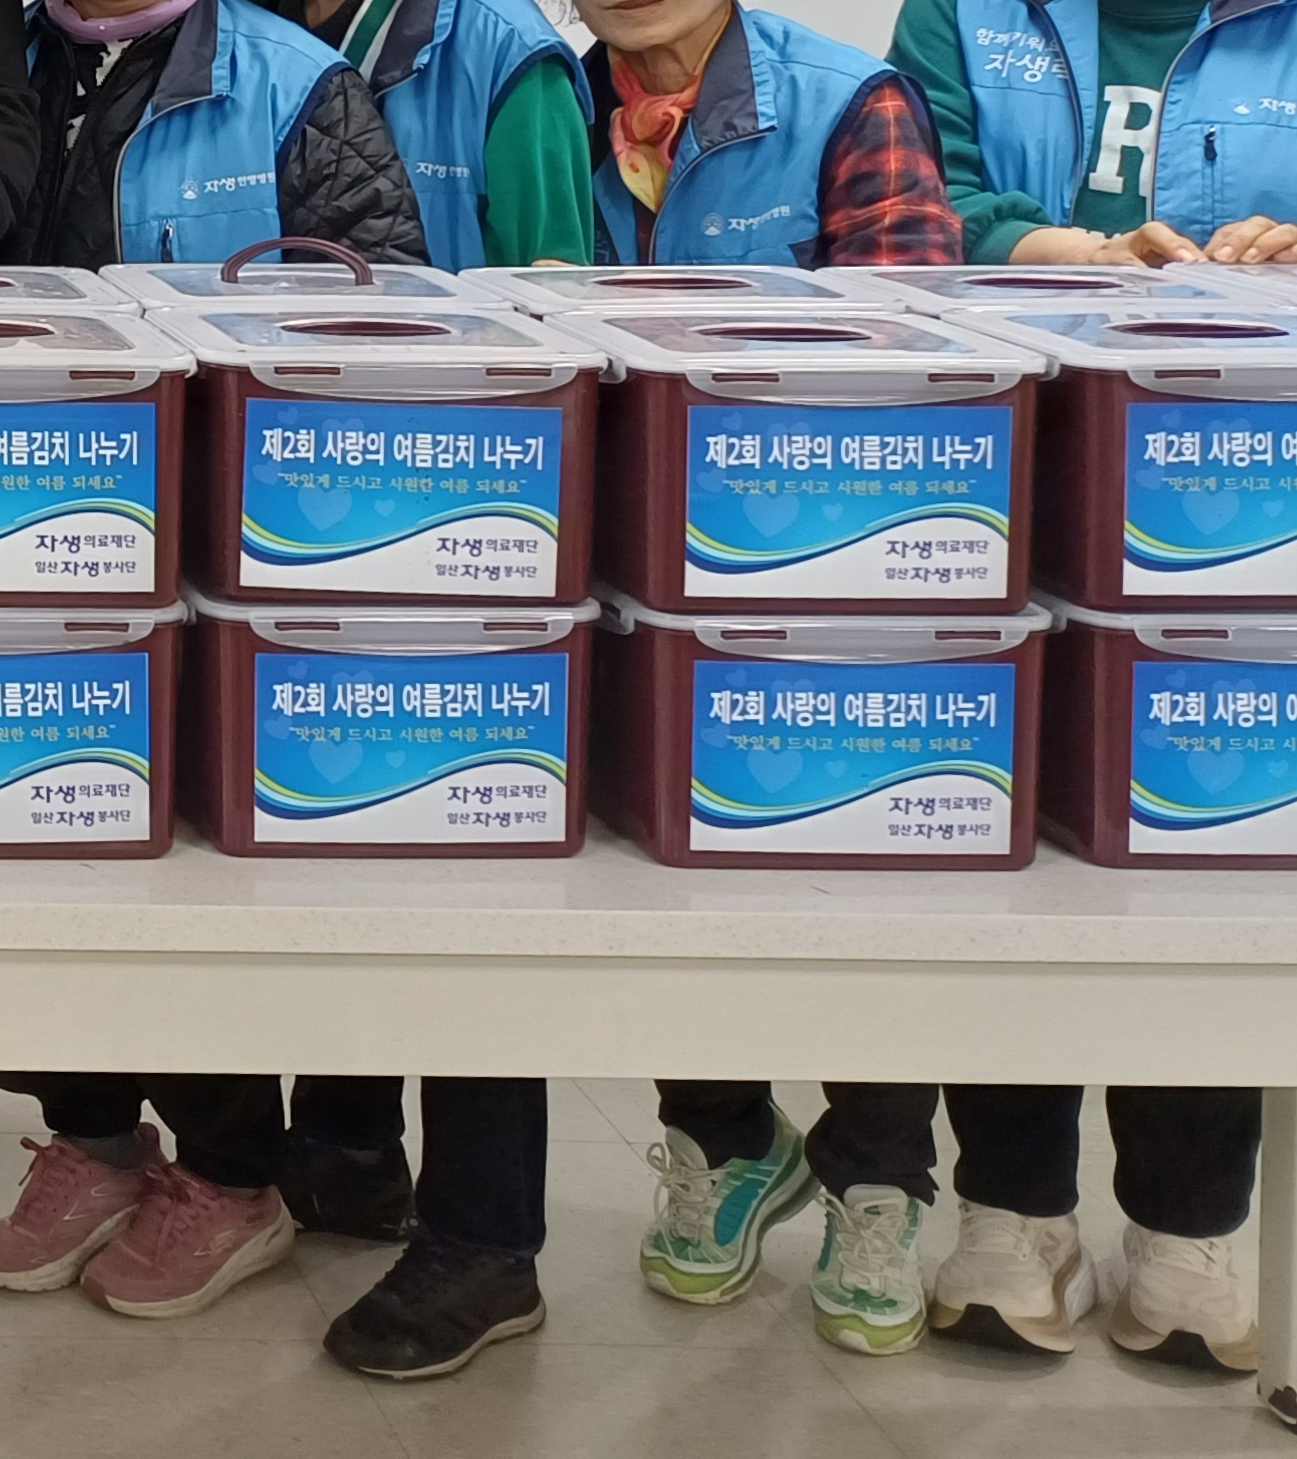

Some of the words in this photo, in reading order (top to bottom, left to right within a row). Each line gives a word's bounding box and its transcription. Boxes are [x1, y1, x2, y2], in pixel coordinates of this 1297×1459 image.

[78, 431, 138, 467] 나누기
[261, 427, 316, 464] 제2회
[322, 429, 386, 467] 사랑의
[393, 432, 475, 469] 여름김치
[483, 435, 544, 471] 나누기
[705, 433, 761, 470] 제2회
[768, 433, 832, 471] 사랑의
[841, 434, 924, 471] 여름김치
[932, 435, 993, 472] 나누기
[1143, 431, 1200, 467] 제2회
[1208, 430, 1273, 468] 사랑의
[36, 474, 66, 491] 여름
[35, 533, 137, 555] 자생의료재단
[71, 680, 131, 717] 나누기
[272, 682, 325, 718] 제2회
[332, 681, 394, 719] 사랑의
[403, 682, 483, 718] 여름김치
[491, 682, 550, 718] 나누기
[709, 690, 765, 726] 제2회
[772, 690, 836, 728] 사랑의
[844, 691, 927, 728] 여름김치
[935, 693, 996, 729] 나누기
[1148, 691, 1205, 726] 제2회
[1213, 691, 1278, 728] 사랑의
[30, 783, 131, 805] 자생의료재단
